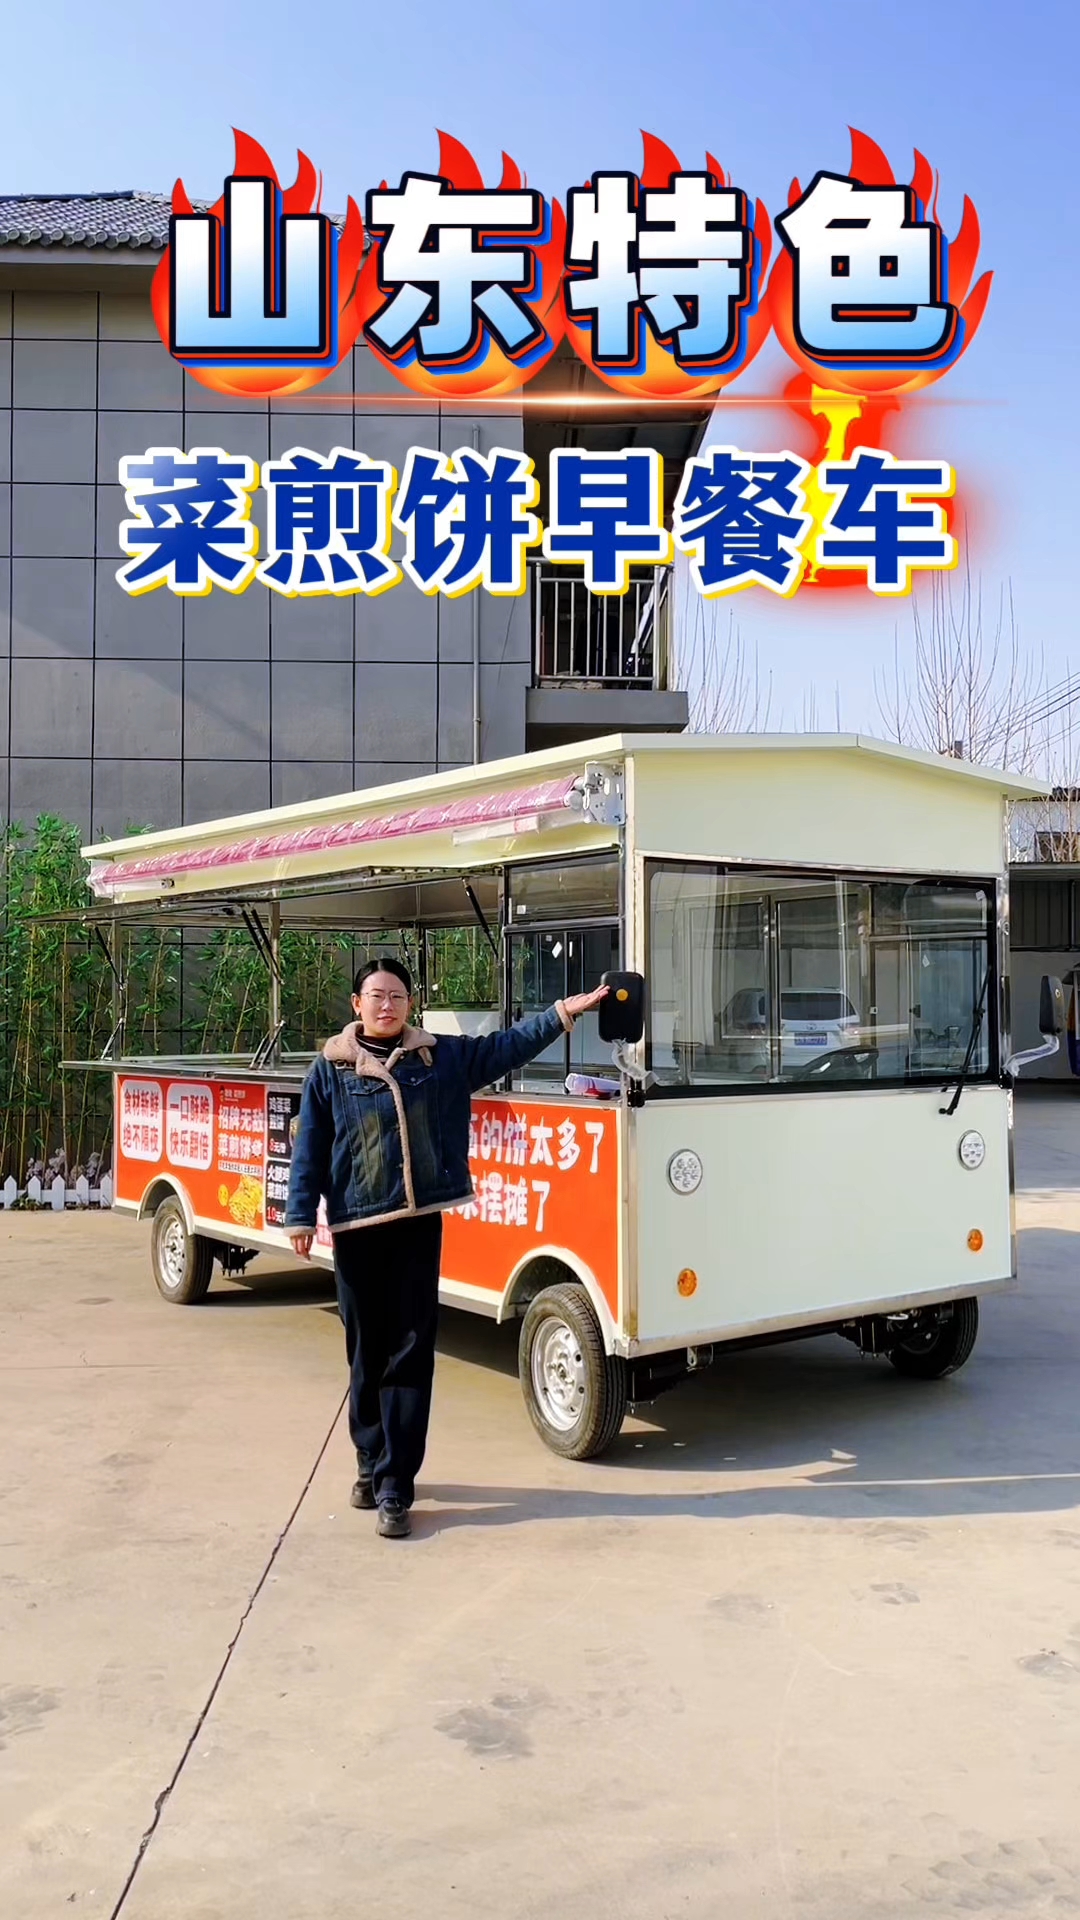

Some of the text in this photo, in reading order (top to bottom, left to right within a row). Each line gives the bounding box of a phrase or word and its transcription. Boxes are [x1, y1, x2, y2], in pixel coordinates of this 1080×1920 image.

[124, 1088, 160, 1119] 食材新鲜
[169, 1094, 210, 1125] 一口酥脆
[218, 1104, 265, 1134] 招牌无敌
[123, 1121, 160, 1153] 绝不隔夜
[169, 1127, 210, 1161] 快乐翻倍
